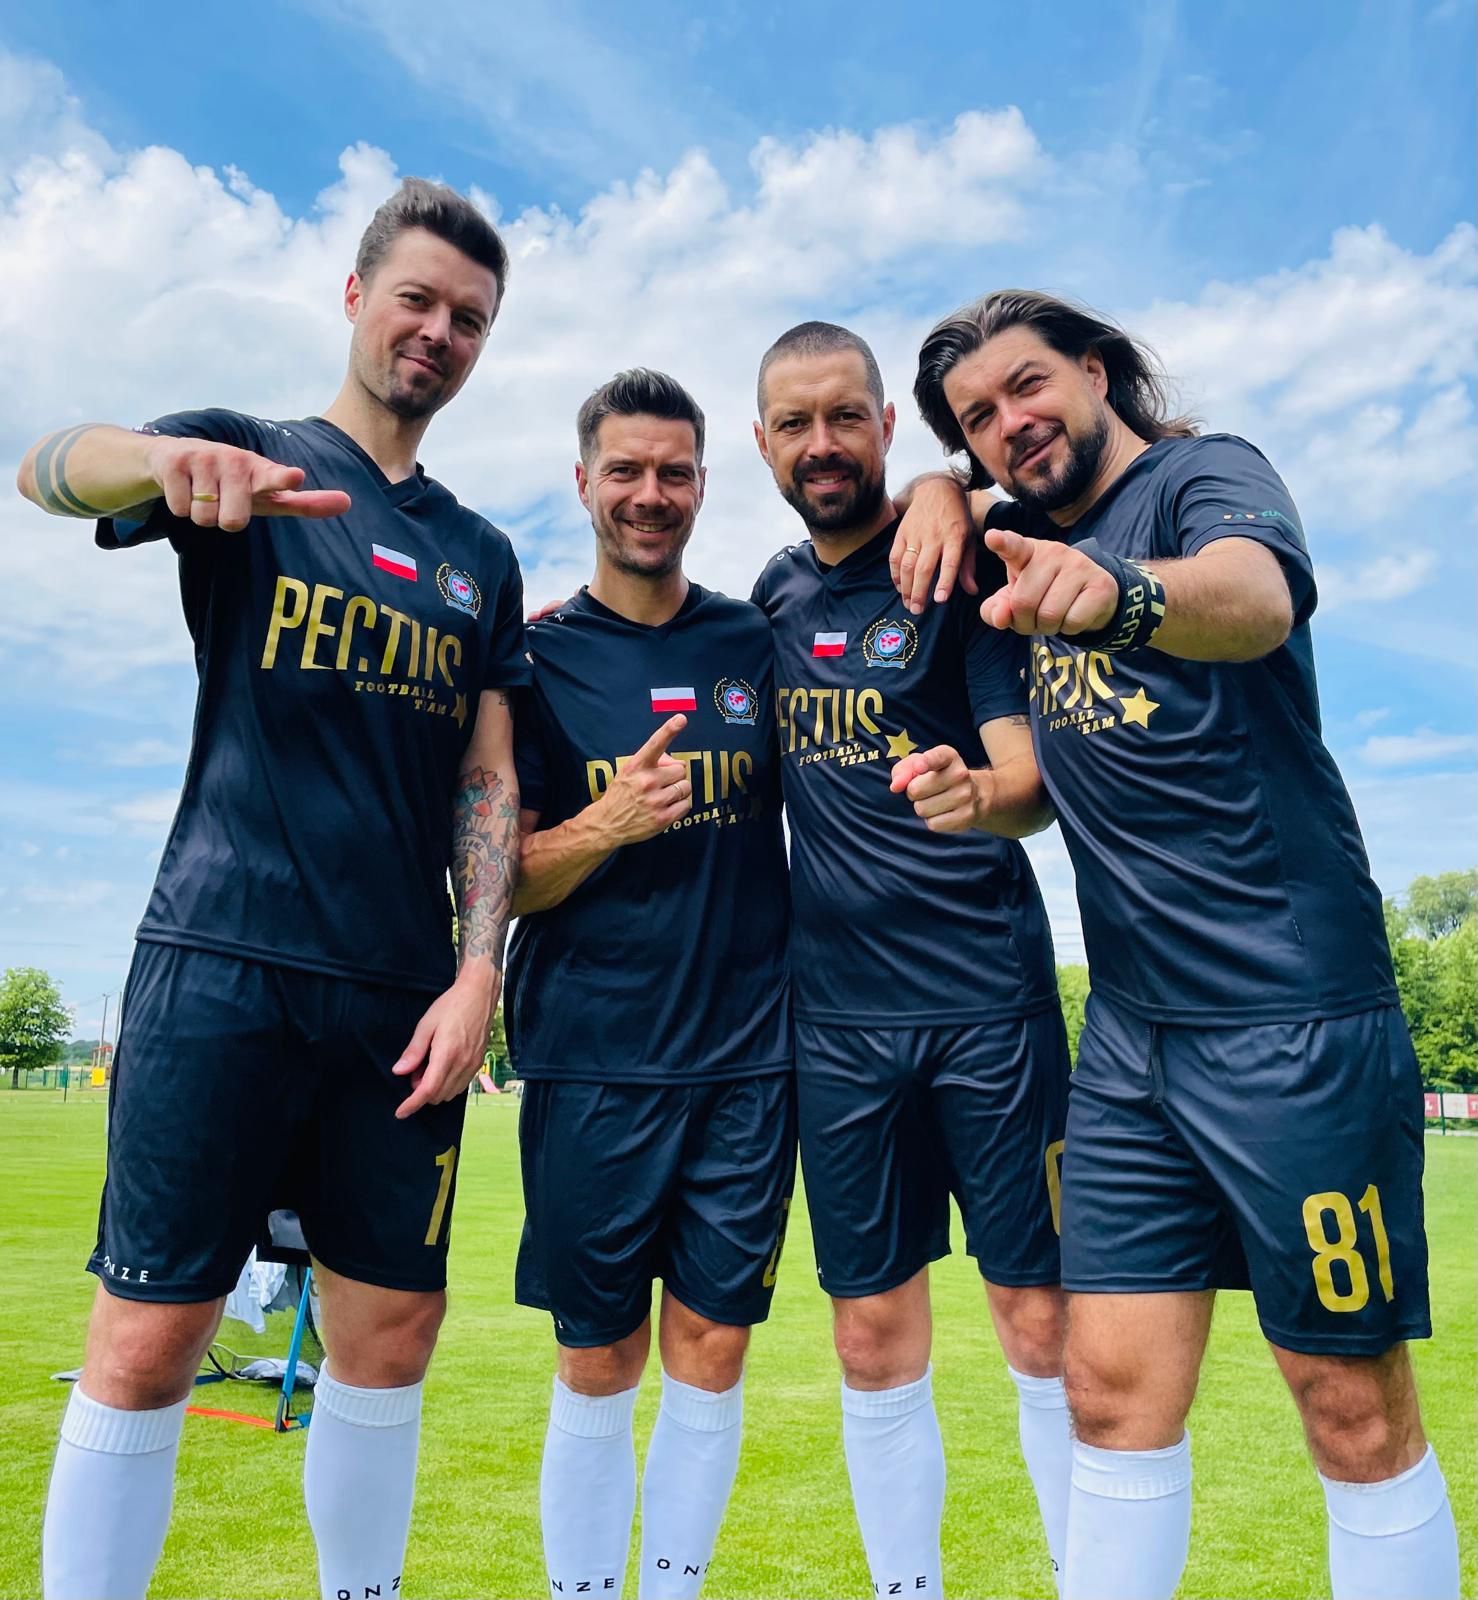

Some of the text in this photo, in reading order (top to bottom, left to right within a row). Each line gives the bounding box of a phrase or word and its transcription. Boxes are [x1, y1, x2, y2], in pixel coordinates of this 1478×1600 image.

[260, 575, 463, 687] PECTUS
[774, 687, 884, 758] ECTUS
[1076, 715, 1116, 736] EAM
[585, 750, 754, 811] PTUS
[798, 742, 862, 767] FOOTBALL
[839, 749, 881, 768] TEAM
[1302, 1183, 1395, 1313] 81
